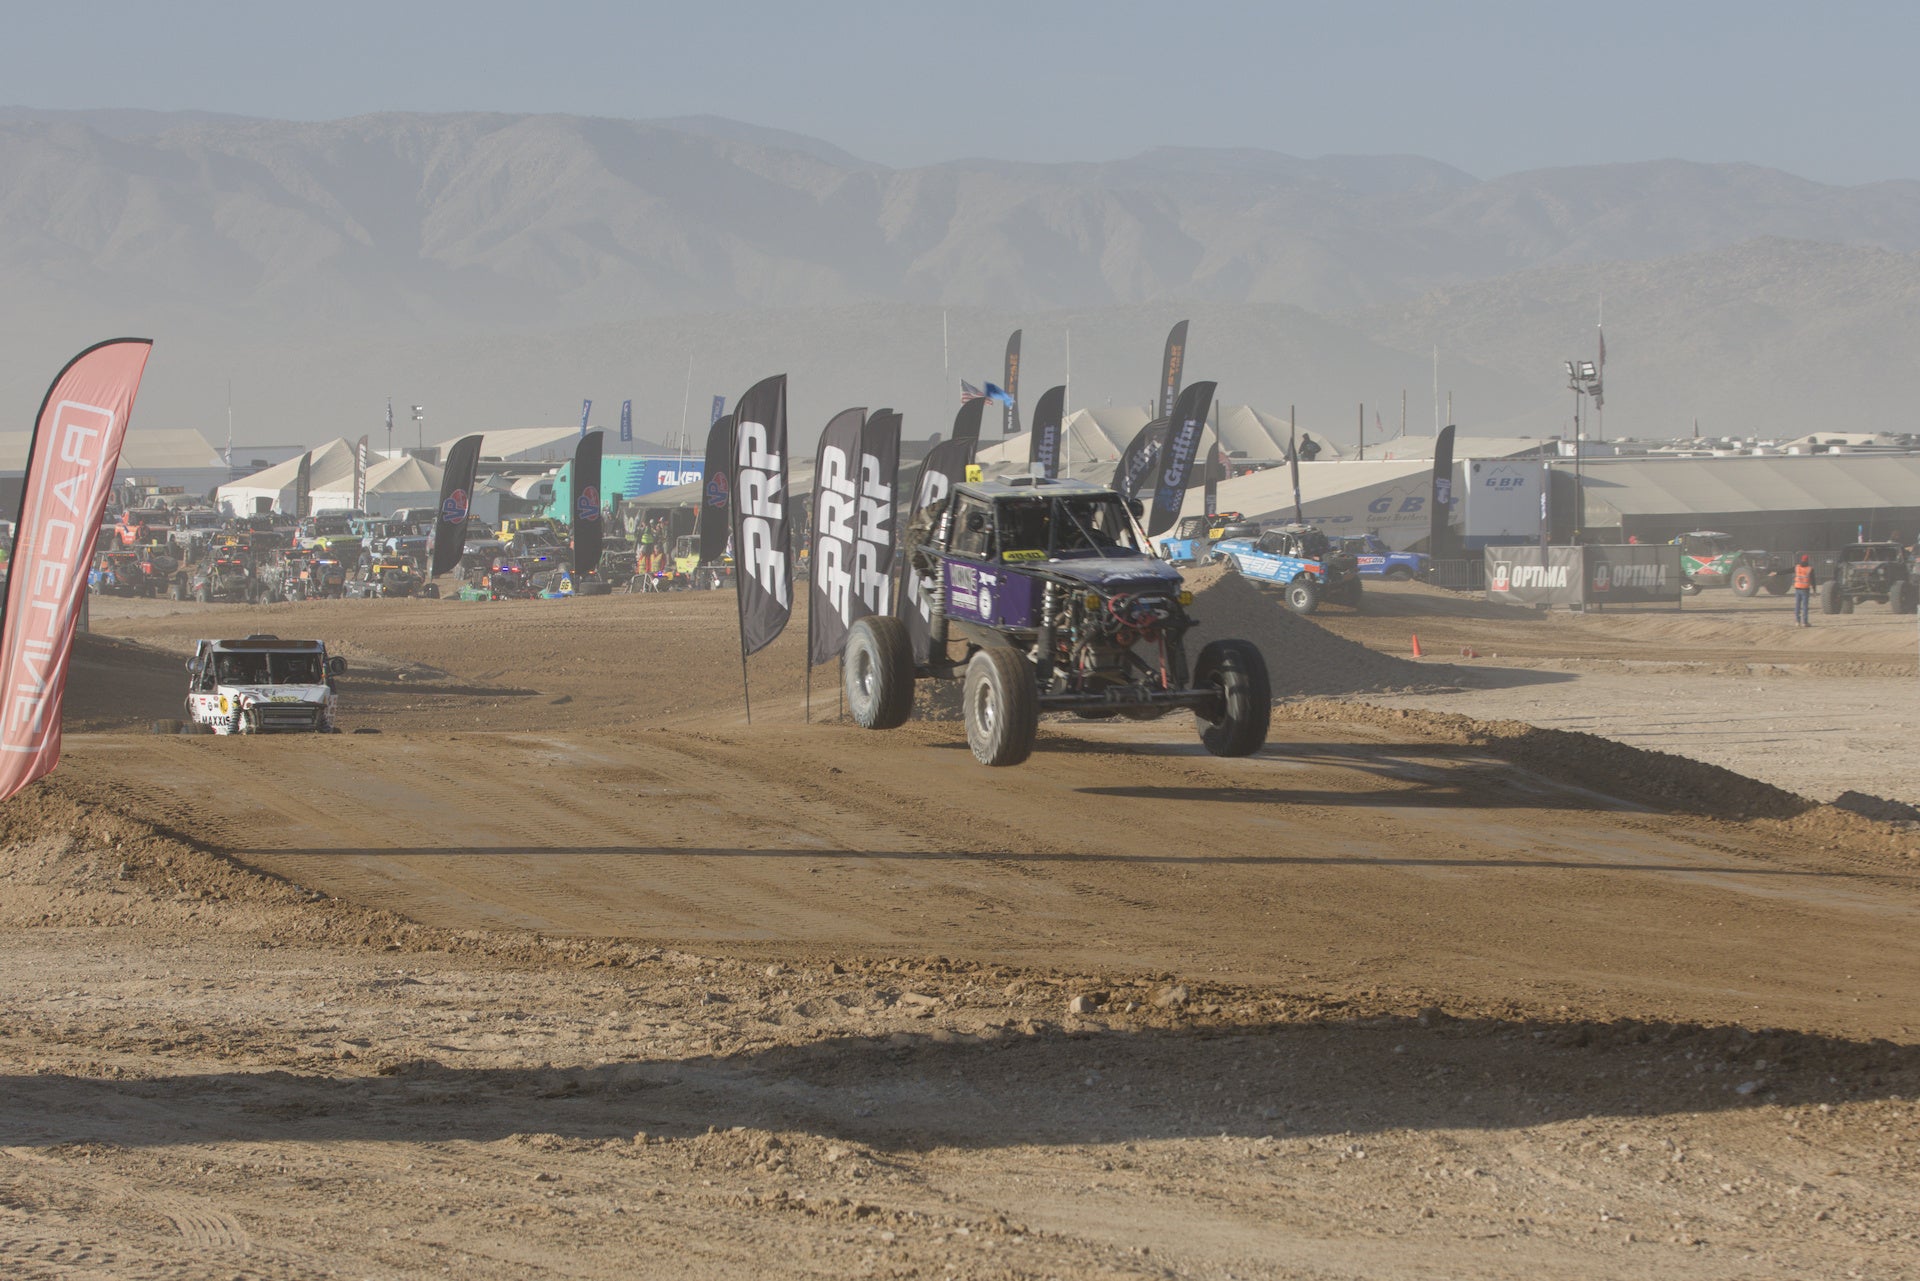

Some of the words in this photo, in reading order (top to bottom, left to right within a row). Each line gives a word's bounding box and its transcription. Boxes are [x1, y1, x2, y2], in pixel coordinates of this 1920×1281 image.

[1164, 418, 1197, 487] Griffin
[706, 480, 727, 504] VP
[1485, 477, 1524, 486] GBR
[443, 497, 466, 522] VP
[578, 494, 598, 519] VP
[738, 421, 788, 610] PRP
[818, 445, 855, 630] PRP
[854, 453, 891, 616] PRP
[1512, 565, 1568, 587] OPTIMA
[1613, 564, 1667, 587] OPTIMA
[201, 715, 230, 726] MAXXIS
